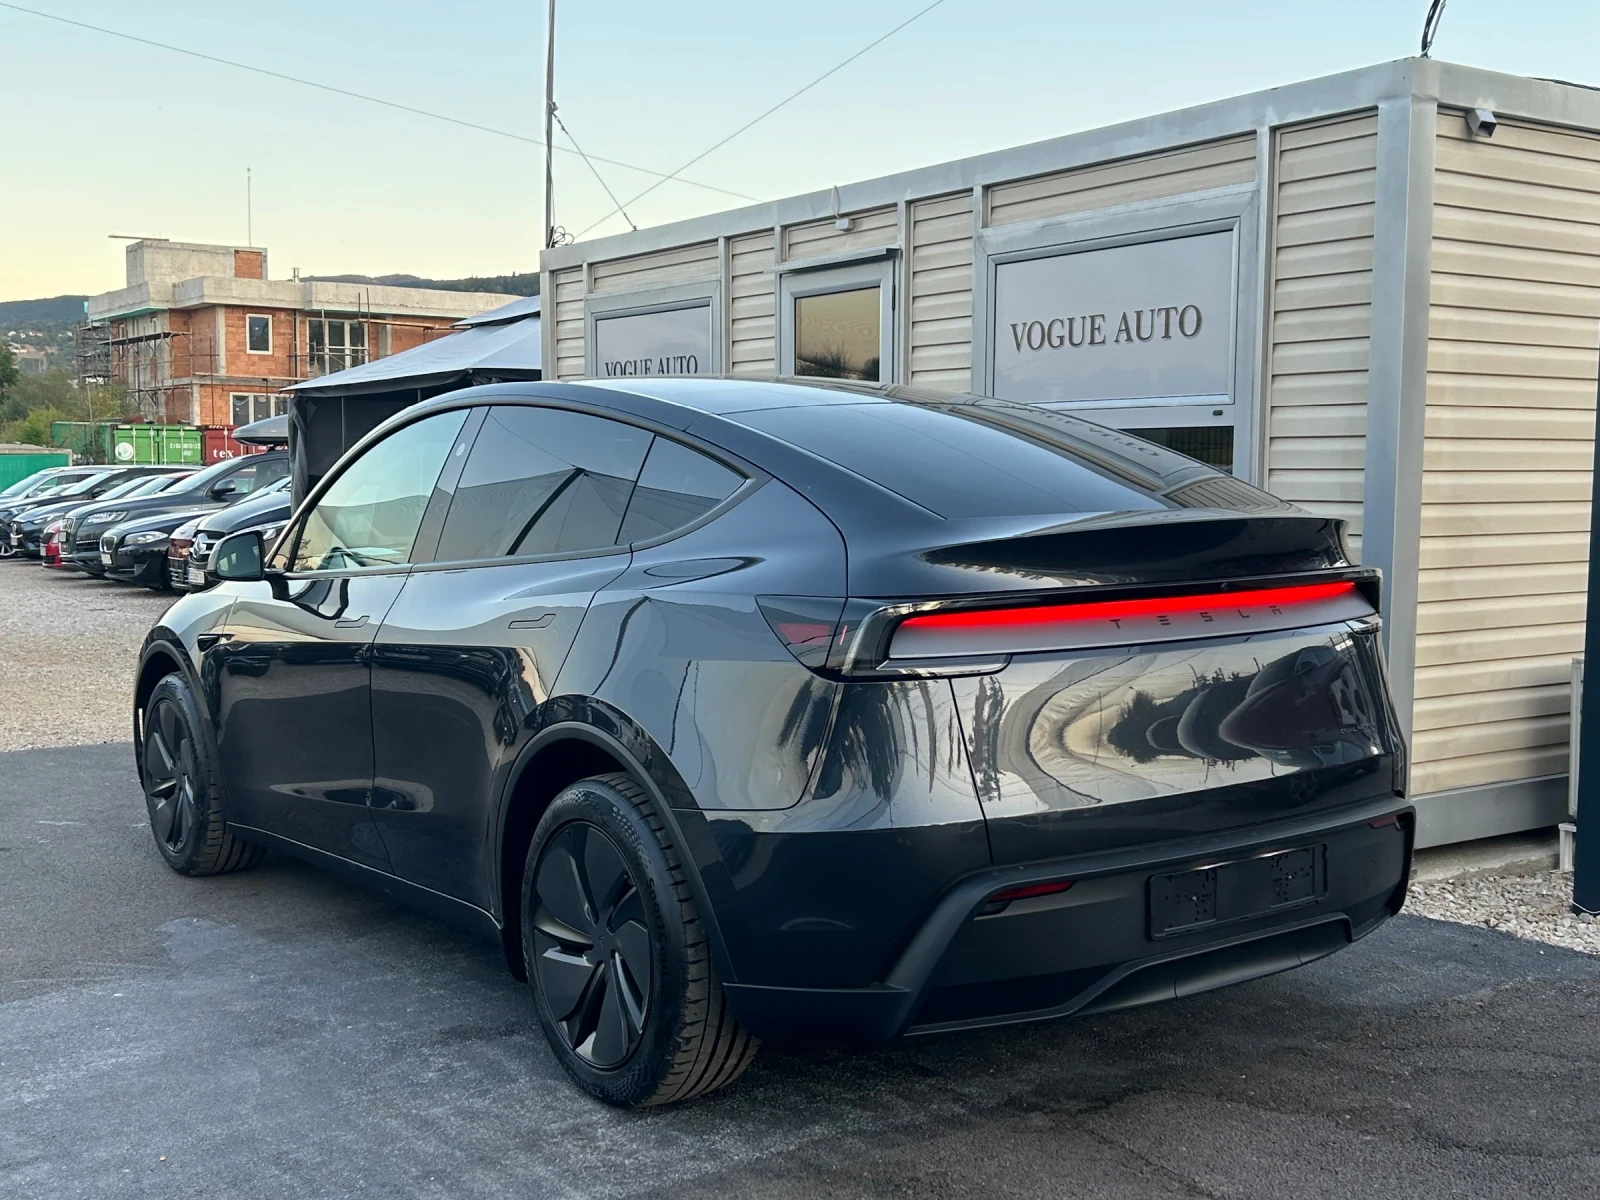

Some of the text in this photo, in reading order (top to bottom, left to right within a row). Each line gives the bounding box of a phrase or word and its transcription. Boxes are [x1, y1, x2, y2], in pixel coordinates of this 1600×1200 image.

[1010, 304, 1203, 353] VOGUE AUTO
[604, 354, 698, 377] VOGUE AUTO
[212, 448, 234, 459] tex
[1109, 604, 1283, 630] TESLA
